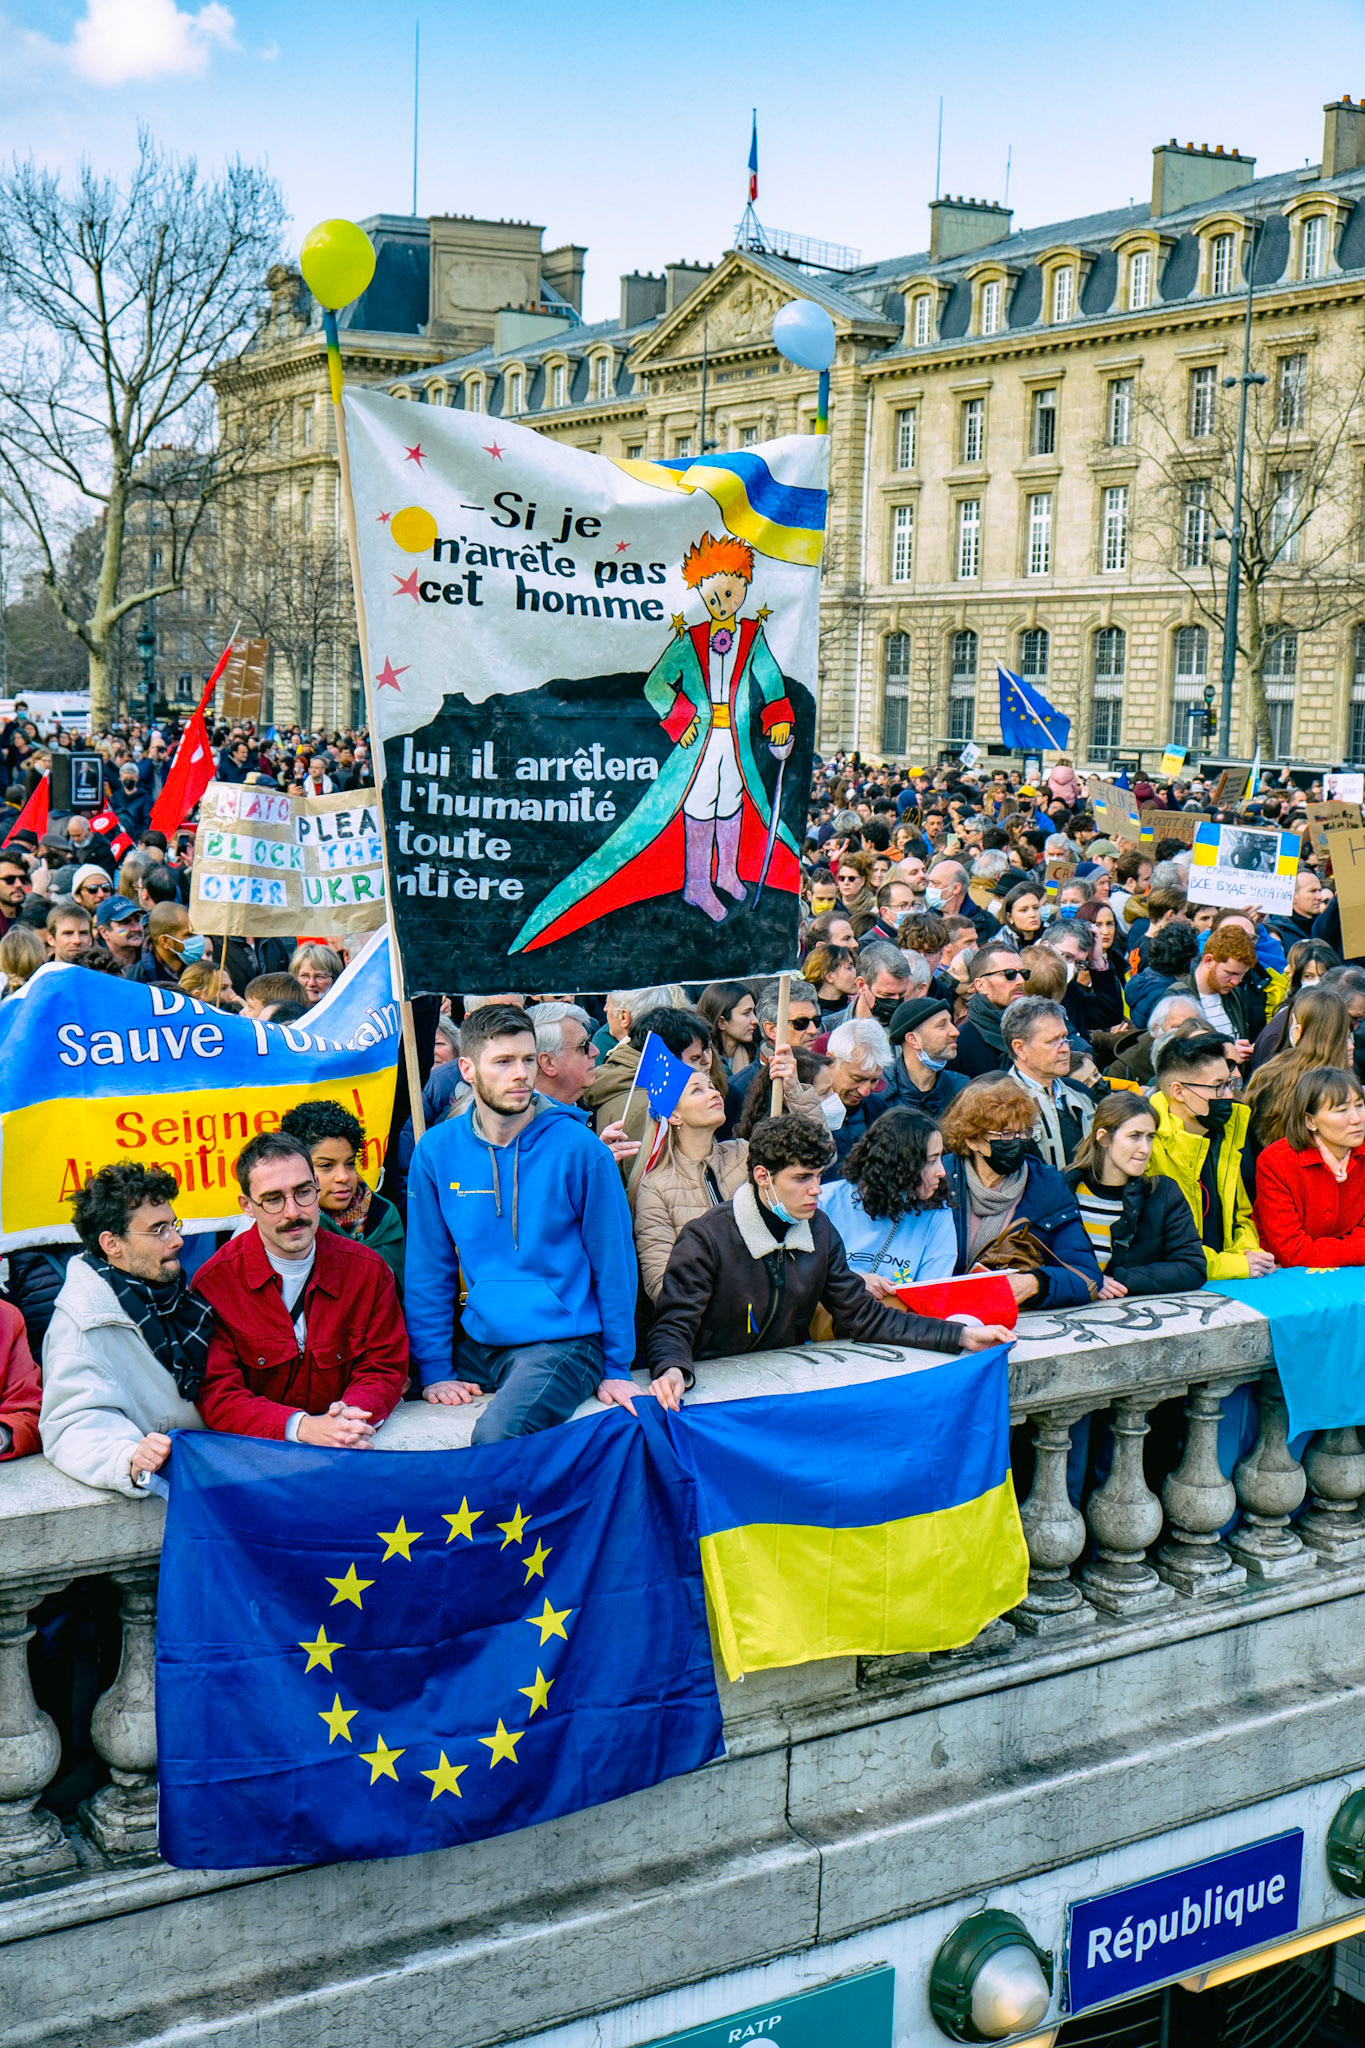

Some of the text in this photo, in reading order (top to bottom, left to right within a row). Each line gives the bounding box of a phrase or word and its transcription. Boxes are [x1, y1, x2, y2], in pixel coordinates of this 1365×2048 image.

[551, 507, 602, 544] je
[433, 535, 667, 588] n'arrête pas
[419, 570, 665, 621] cet homme
[402, 736, 499, 779] lui il
[515, 742, 660, 781] arrêtera
[220, 790, 378, 843] NATO PLEA
[399, 779, 617, 822] l'humanité
[207, 833, 304, 869] BLOCK
[395, 820, 512, 861] toute
[203, 873, 385, 905] OVER UKR
[396, 863, 525, 901] ntière
[1190, 876, 1212, 889] ВСЕ
[1216, 880, 1247, 896] БУДЕ
[57, 1023, 225, 1067] Sauve
[115, 1109, 291, 1152] Seigne
[1086, 1874, 1287, 1969] République
[728, 2015, 782, 2044] RATP
